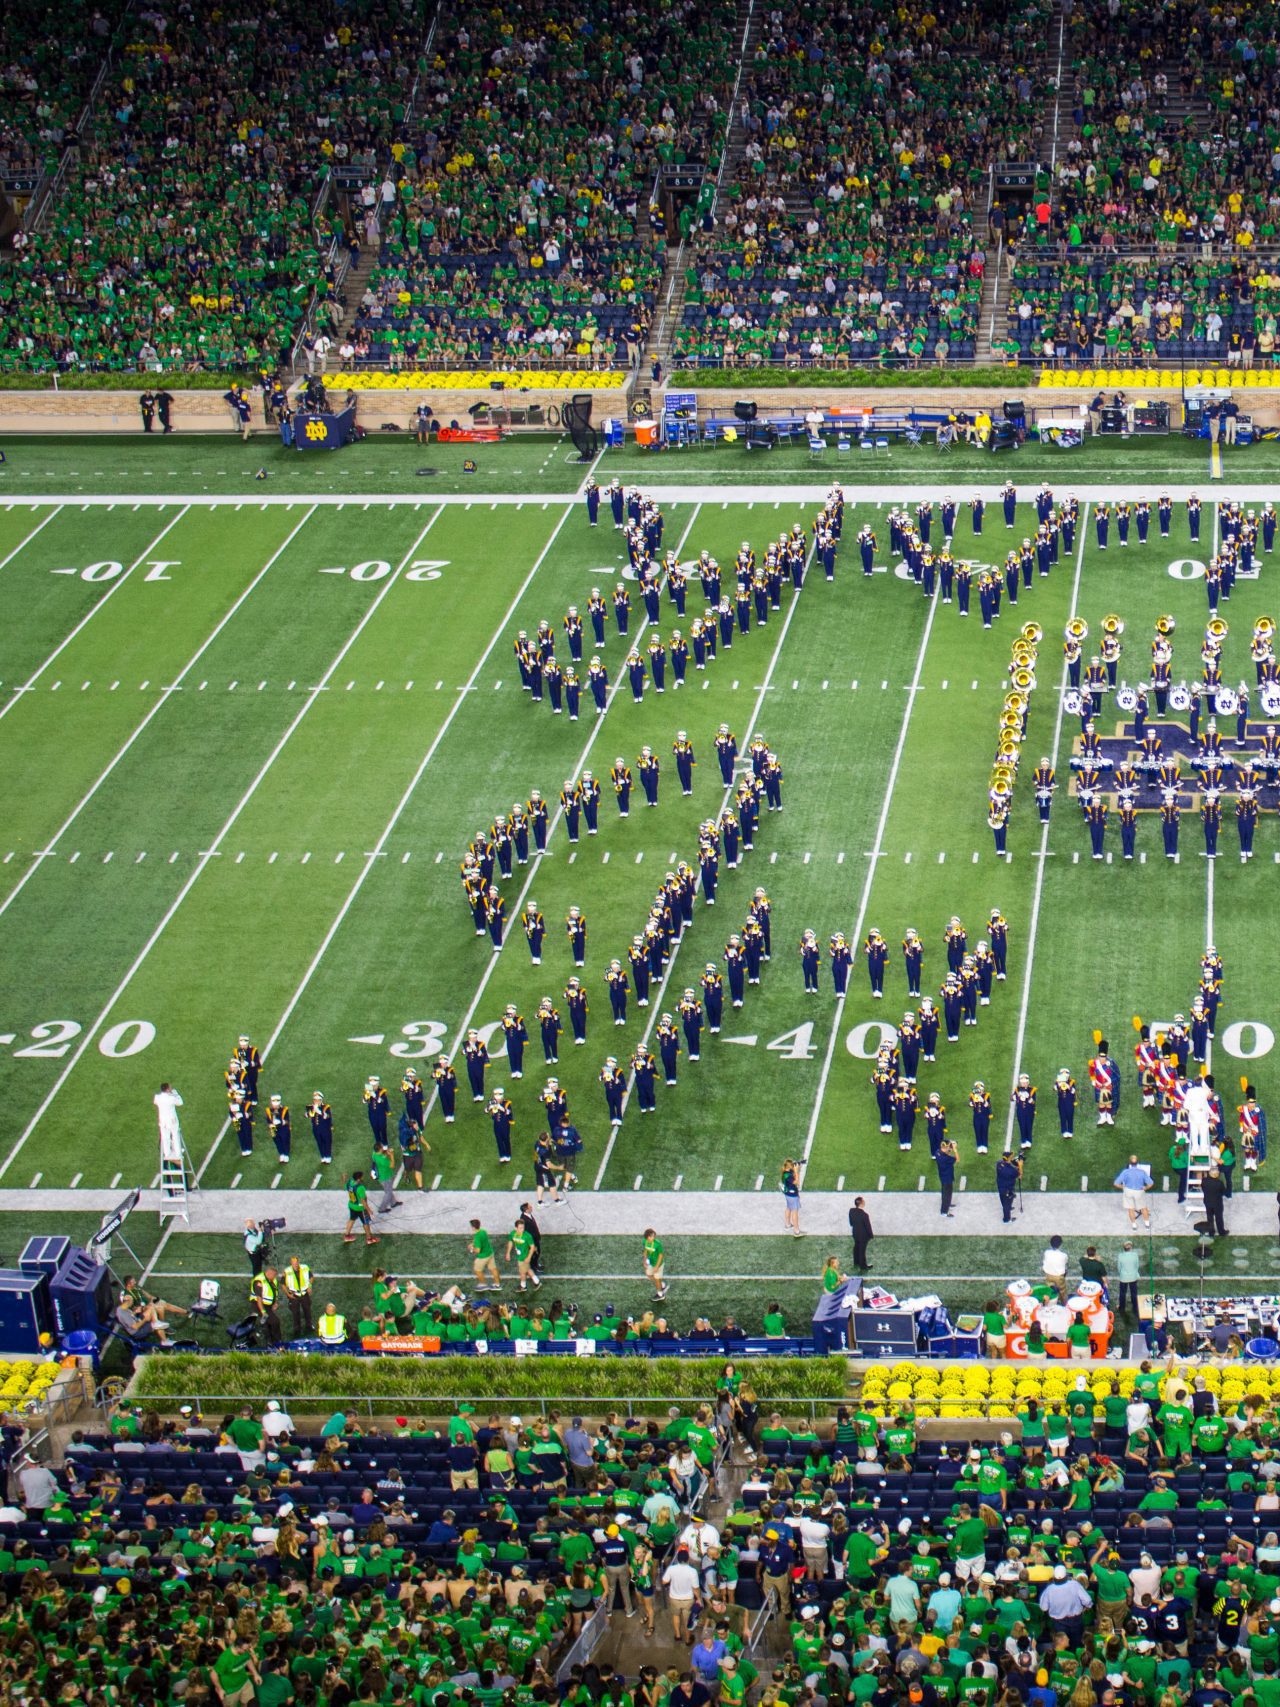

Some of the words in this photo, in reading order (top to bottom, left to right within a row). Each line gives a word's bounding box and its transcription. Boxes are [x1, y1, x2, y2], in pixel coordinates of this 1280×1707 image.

[81, 561, 181, 581] 10
[350, 560, 450, 580] 20
[13, 1020, 157, 1058] 20
[1166, 1614, 1179, 1630] 3
[1226, 1610, 1239, 1626] 2
